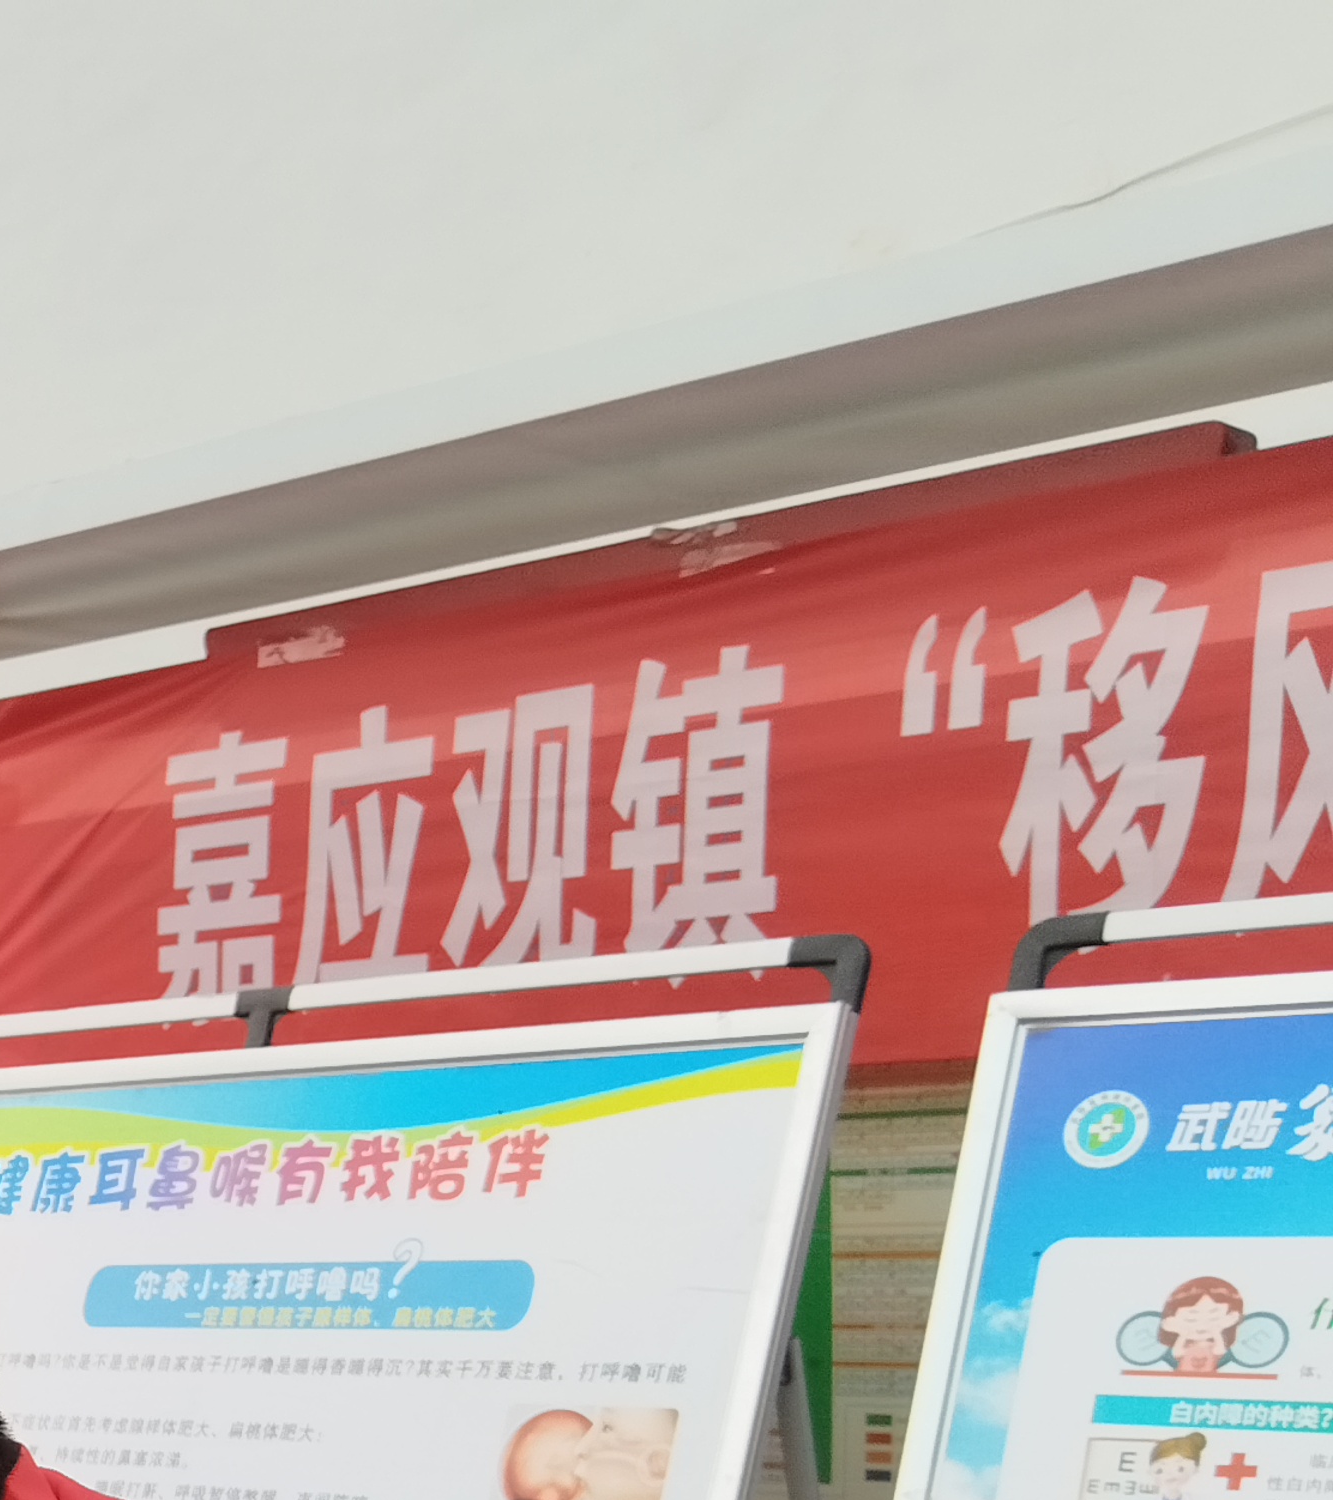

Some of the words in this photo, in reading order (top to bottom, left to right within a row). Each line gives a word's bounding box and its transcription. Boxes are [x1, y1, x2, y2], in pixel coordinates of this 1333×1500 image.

[155, 645, 785, 1000] 嘉应观镇
[1207, 1166, 1237, 1180] WU
[1242, 1165, 1274, 1180] ZHI
